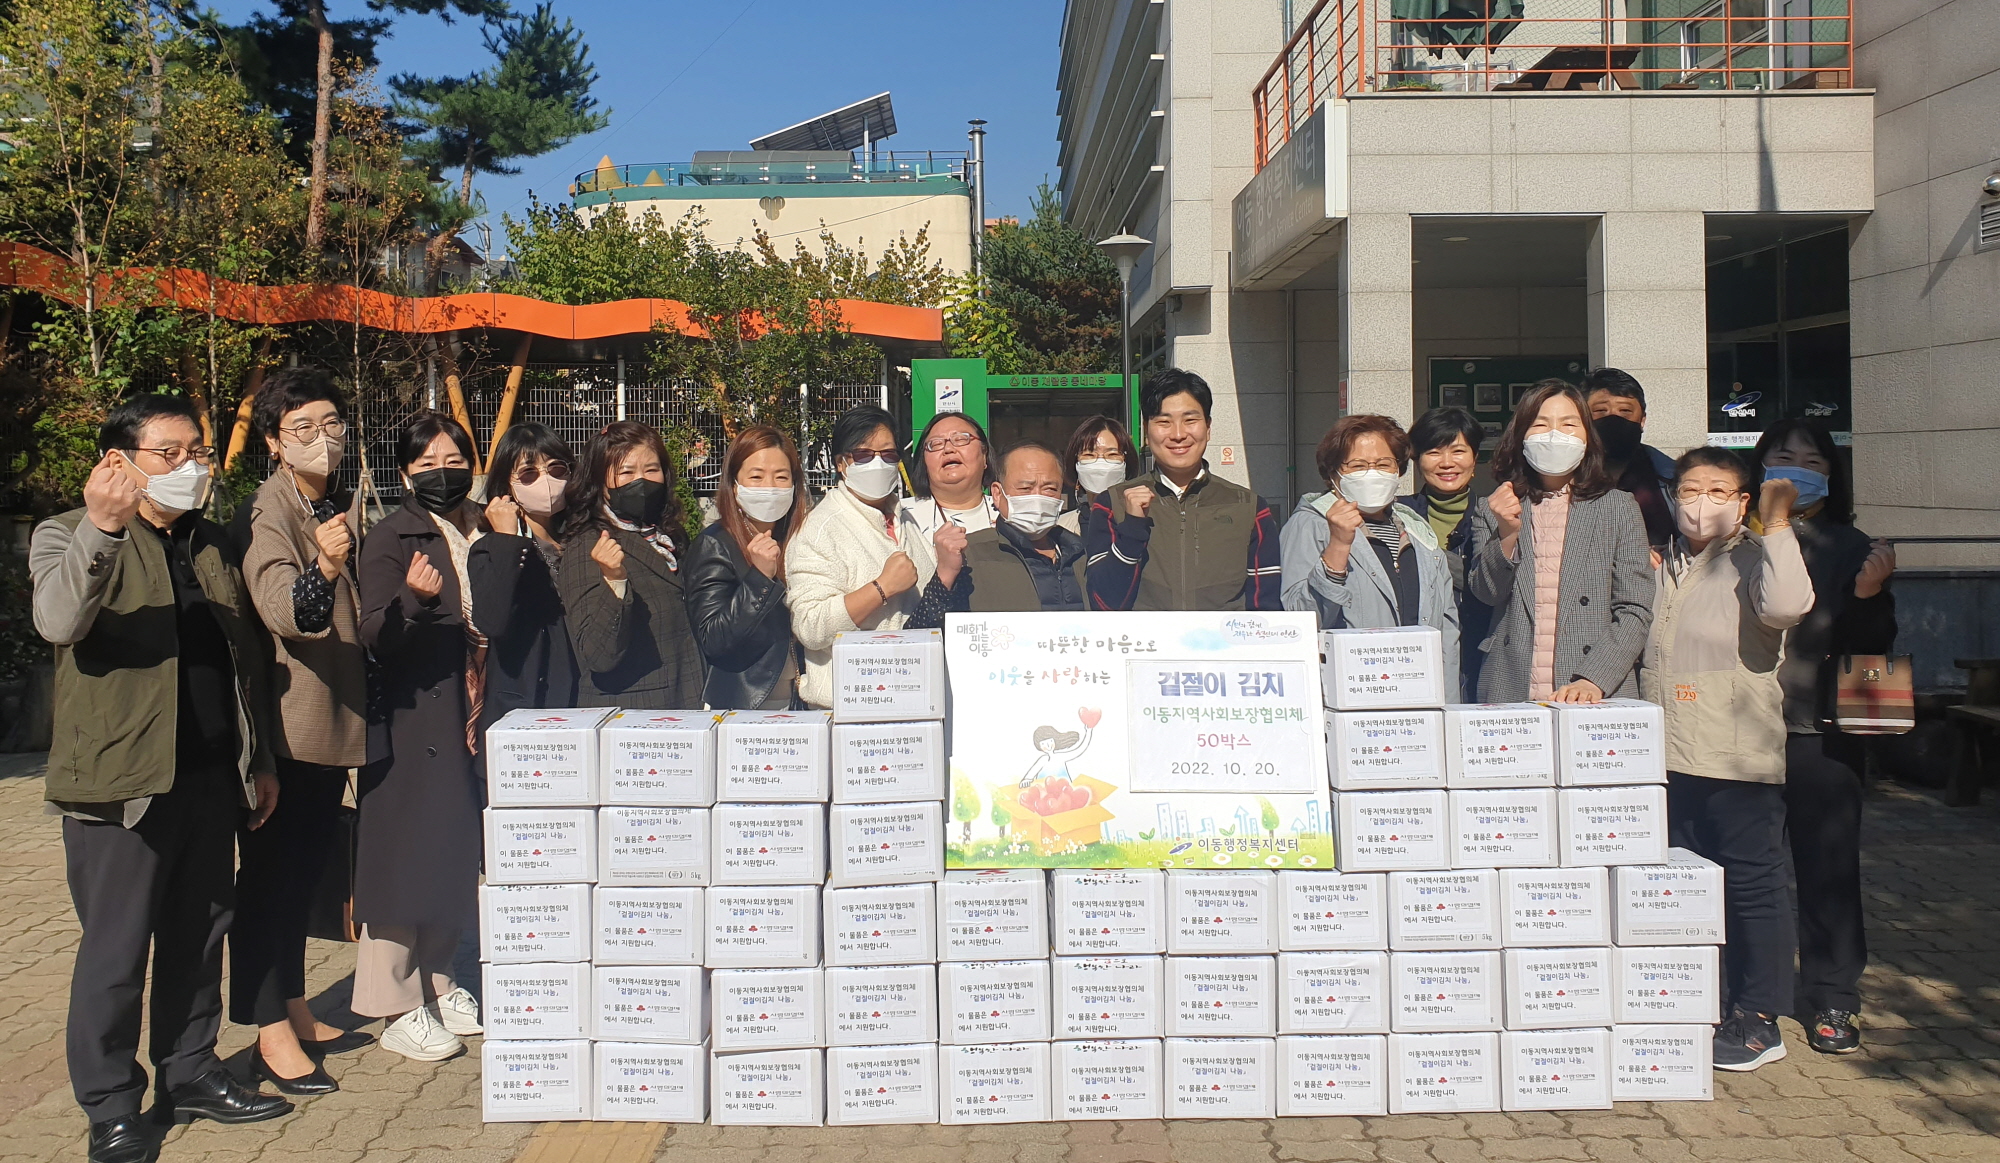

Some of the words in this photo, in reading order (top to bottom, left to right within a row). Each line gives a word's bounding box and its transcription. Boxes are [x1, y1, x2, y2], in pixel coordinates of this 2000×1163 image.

[1236, 188, 1254, 242] 이동
[1256, 119, 1316, 228] 행정복지센터
[1294, 194, 1315, 223] Center
[1021, 376, 1039, 386] 이동
[1714, 435, 1728, 443] 이동
[956, 621, 988, 635] 매화가
[971, 633, 989, 643] 피는
[1037, 636, 1089, 654] 따뜻한
[1096, 634, 1157, 654] 마음으로
[968, 643, 992, 658] 이동
[1350, 646, 1422, 656] 이동지역사회보장협의체
[848, 658, 921, 666] 이동지역사회보장협의체
[989, 666, 1035, 686] 이웃을
[1041, 665, 1111, 686] 사랑하는
[1237, 671, 1285, 698] 김치
[1675, 690, 1698, 701] 129
[844, 697, 857, 705] 에서
[1143, 706, 1303, 724] 이동지역사회보장협의체
[1353, 718, 1424, 727] 이동지역사회보장협의체
[1469, 717, 1540, 727] 이동지역사회보장협의체
[1578, 722, 1648, 731] 이동지역사회보장협의체
[735, 738, 809, 746] 이동지역사회보장협의체
[850, 736, 922, 747] 이동지역사회보장협의체
[1196, 733, 1252, 750] 50박스
[503, 744, 576, 752] 이동지역사회보장협의체
[619, 742, 692, 750] 이동지역사회보장협의체
[1468, 758, 1481, 766] 에서
[857, 766, 876, 774] 물품은
[1171, 763, 1216, 776] 2022.
[1222, 763, 1247, 776] 10.
[1255, 763, 1280, 776] 20.
[848, 779, 861, 787] 에서
[1360, 808, 1432, 816] 이동지역사회보장협의체
[1466, 806, 1537, 814] 이동지역사회보장협의체
[1578, 805, 1649, 814] 이동지역사회보장협의체
[850, 813, 924, 826] 이동지역사회보장협의체
[502, 822, 575, 831] 이동지역사회보장협의체
[729, 820, 803, 828] 이동지역사회보장협의체
[1197, 837, 1300, 854] 이동행정복지센터
[726, 860, 739, 868] 에서
[1406, 876, 1479, 885] 이동지역사회보장협의체
[1295, 884, 1367, 893] 이동지역사회보장협의체
[1518, 882, 1590, 890] 이동지역사회보장협의체
[1185, 889, 1258, 897] 이동지역사회보장협의체
[609, 900, 682, 910] 이동지역사회보장협의체
[720, 898, 793, 906] 이동지역사회보장협의체
[955, 898, 1028, 907] 이동지역사회보장협의체
[1072, 900, 1145, 908] 이동지역사회보장협의체
[497, 905, 569, 914] 이동지역사회보장협의체
[842, 902, 915, 912] 이동지역사회보장협의체
[1515, 910, 1521, 918] 이
[1525, 910, 1544, 918] 물품은
[1293, 925, 1306, 933] 에서
[1515, 922, 1528, 930] 에서
[505, 933, 523, 941] 물품은
[715, 938, 729, 946] 에서
[952, 939, 965, 947] 에서
[495, 945, 508, 953] 에서
[1527, 961, 1598, 972] 이동지역사회보장협의체
[1631, 963, 1702, 971] 이동지역사회보장협의체
[1297, 968, 1369, 977] 이동지역사회보장협의체
[1407, 967, 1480, 975] 이동지역사회보장협의체
[608, 977, 680, 987] 이동지역사회보장협의체
[1184, 974, 1258, 982] 이동지역사회보장협의체
[496, 979, 568, 987] 이동지역사회보장협의체
[960, 981, 1033, 993] 이동지역사회보장협의체
[729, 985, 804, 995] 이동지역사회보장협의체
[842, 984, 916, 993] 이동지역사회보장협의체
[1071, 985, 1145, 993] 이동지역사회보장협의체
[1525, 992, 1531, 1000] 이
[1535, 991, 1553, 999] 물품은
[1525, 1004, 1538, 1012] 에서
[1181, 1013, 1194, 1021] 에서
[726, 1027, 739, 1035] 에서
[958, 1025, 972, 1033] 에서
[1622, 1038, 1693, 1046] 이동지역사회보장협의체
[1408, 1049, 1481, 1058] 이동지역사회보장협의체
[1521, 1047, 1594, 1055] 이동지역사회보장협의체
[495, 1053, 568, 1061] 이동지역사회보장협의체
[1297, 1053, 1370, 1061] 이동지역사회보장협의체
[610, 1058, 683, 1066] 이동지역사회보장협의체
[847, 1058, 920, 1070] 이동지역사회보장협의체
[1182, 1058, 1256, 1066] 이동지역사회보장협의체
[728, 1064, 801, 1072] 이동지역사회보장협의체
[959, 1067, 1032, 1077] 이동지역사회보장협의체
[1071, 1066, 1145, 1075] 이동지역사회보장협의체
[1416, 1078, 1435, 1086] 물품은
[1618, 1077, 1631, 1085] 에서
[1406, 1090, 1419, 1098] 에서
[845, 1101, 858, 1109] 에서
[1069, 1107, 1082, 1115] 에서
